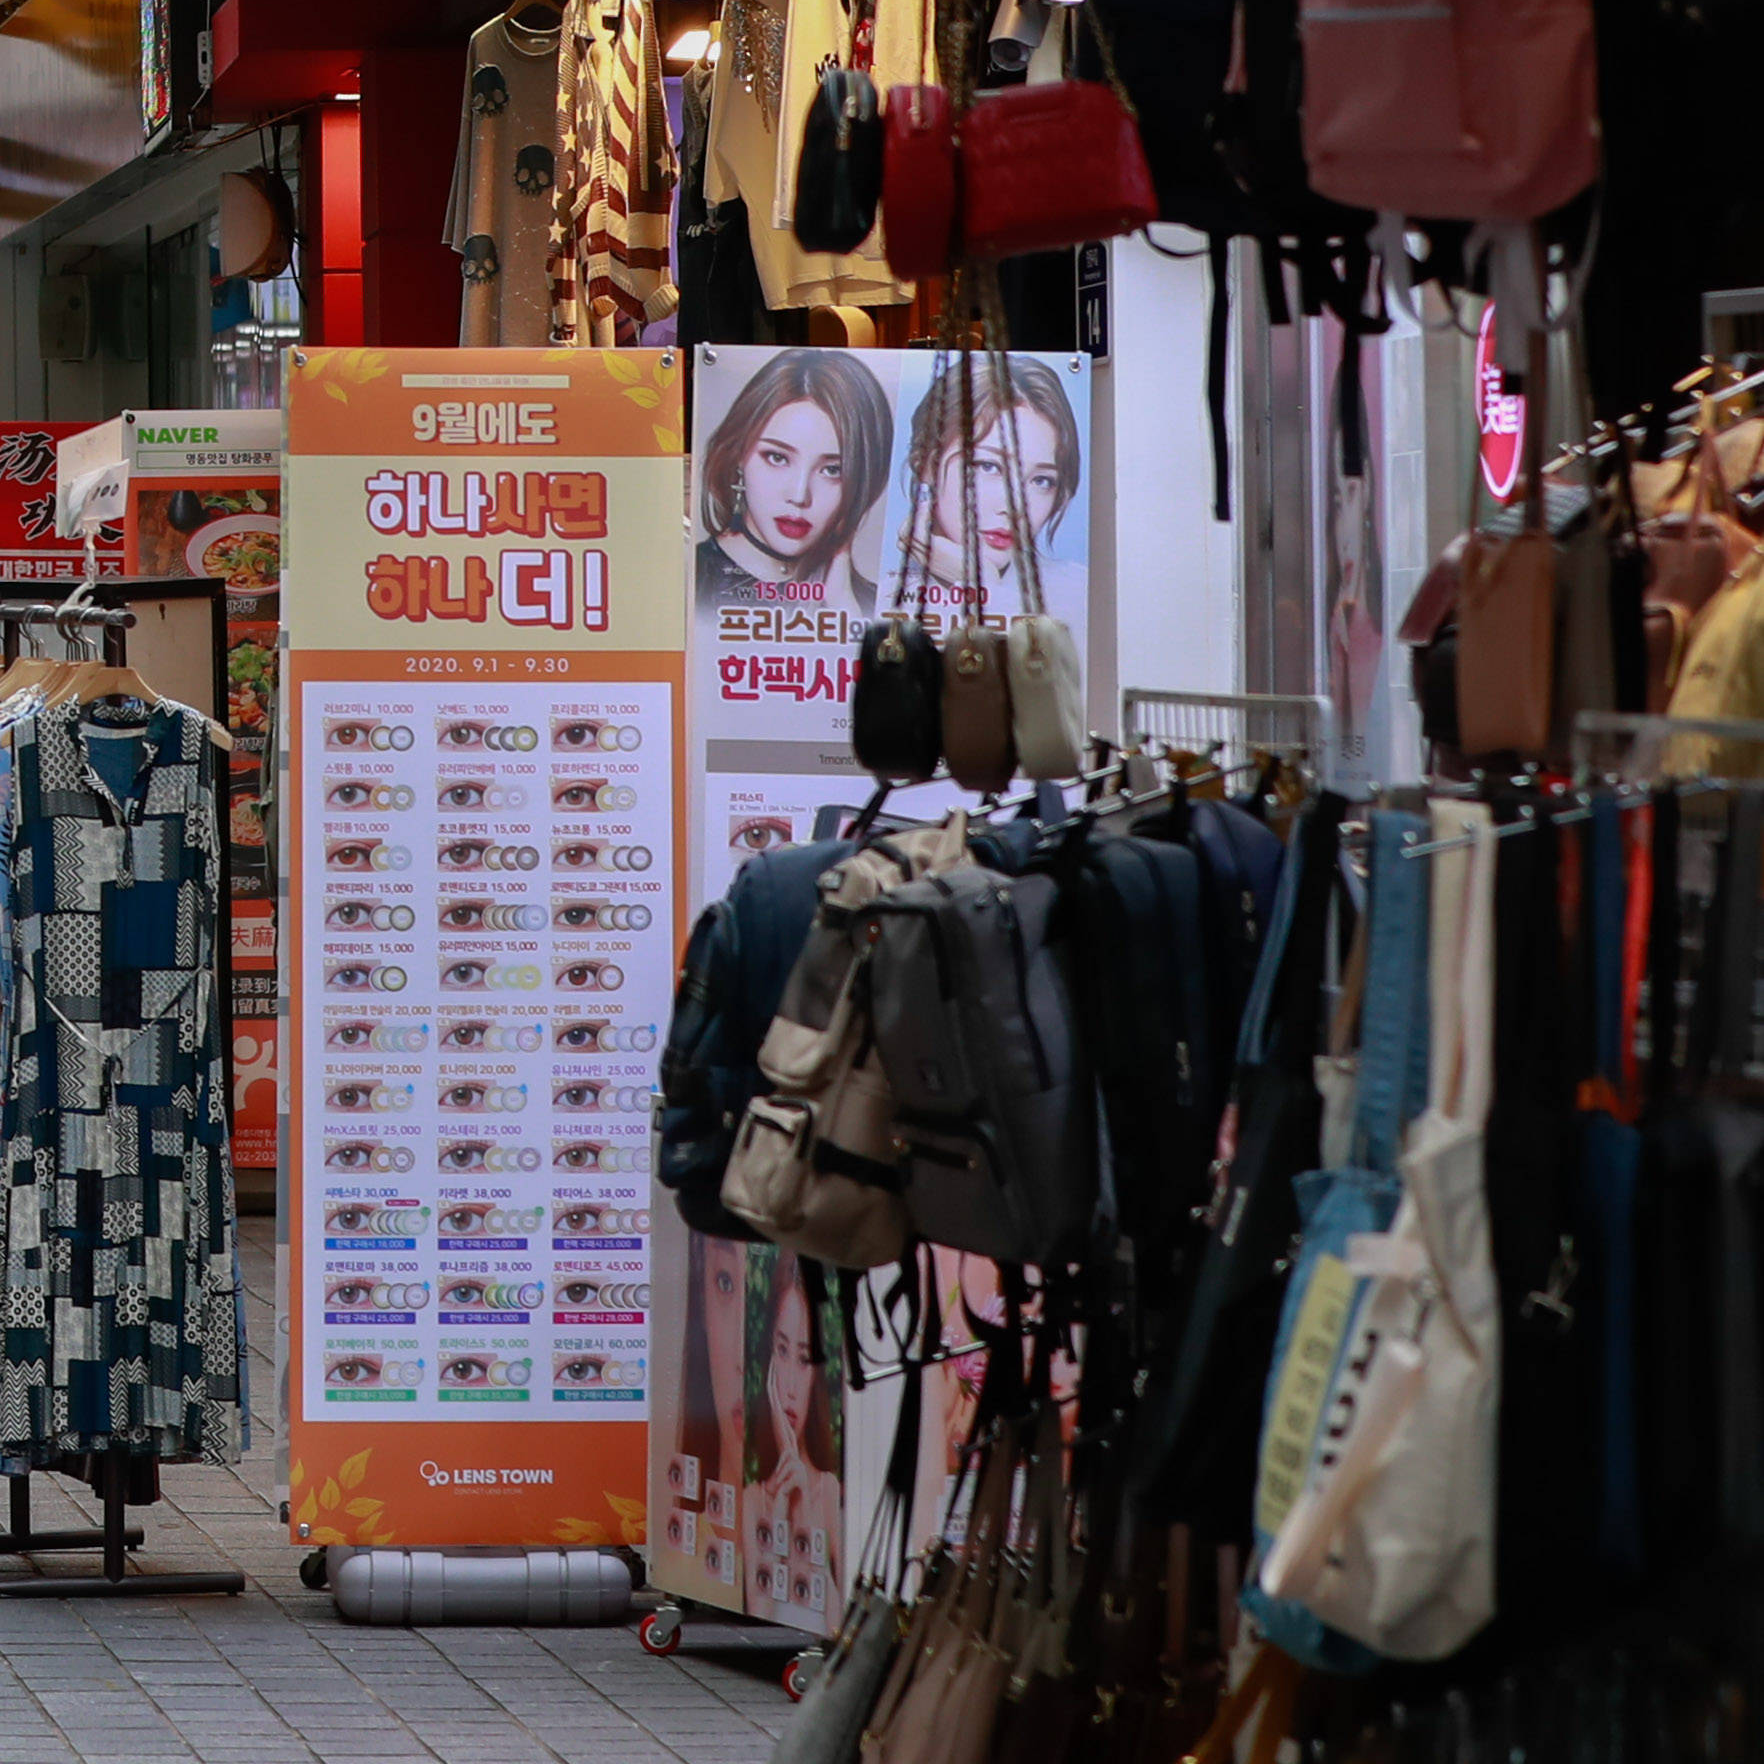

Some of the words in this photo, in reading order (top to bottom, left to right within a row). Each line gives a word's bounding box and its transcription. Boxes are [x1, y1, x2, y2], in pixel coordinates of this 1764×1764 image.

[412, 401, 558, 446] 9월에도
[136, 427, 220, 445] NAVER
[185, 452, 228, 466] 명동맛집
[365, 469, 609, 541] 하나사면
[365, 553, 494, 623] 하나
[405, 657, 465, 674] 2020.
[524, 657, 570, 674] 9.30
[717, 654, 863, 704] 한팩사
[376, 703, 414, 716] 10,000
[357, 763, 394, 775] 10,000
[500, 763, 537, 775] 10,000
[493, 823, 531, 836] 15,000
[596, 823, 632, 836] 15,000
[378, 883, 414, 895] 15,000
[379, 942, 415, 955] 15,000
[394, 1004, 433, 1017] 20,000
[478, 1064, 517, 1077] 20,000
[383, 1124, 422, 1137] 25,000
[380, 1260, 419, 1274] 38,000
[493, 1260, 533, 1274] 38,000
[606, 1259, 644, 1273] 45,000
[608, 1338, 647, 1350] 60,000
[453, 1468, 496, 1485] LENS
[500, 1468, 554, 1485] TOWN
